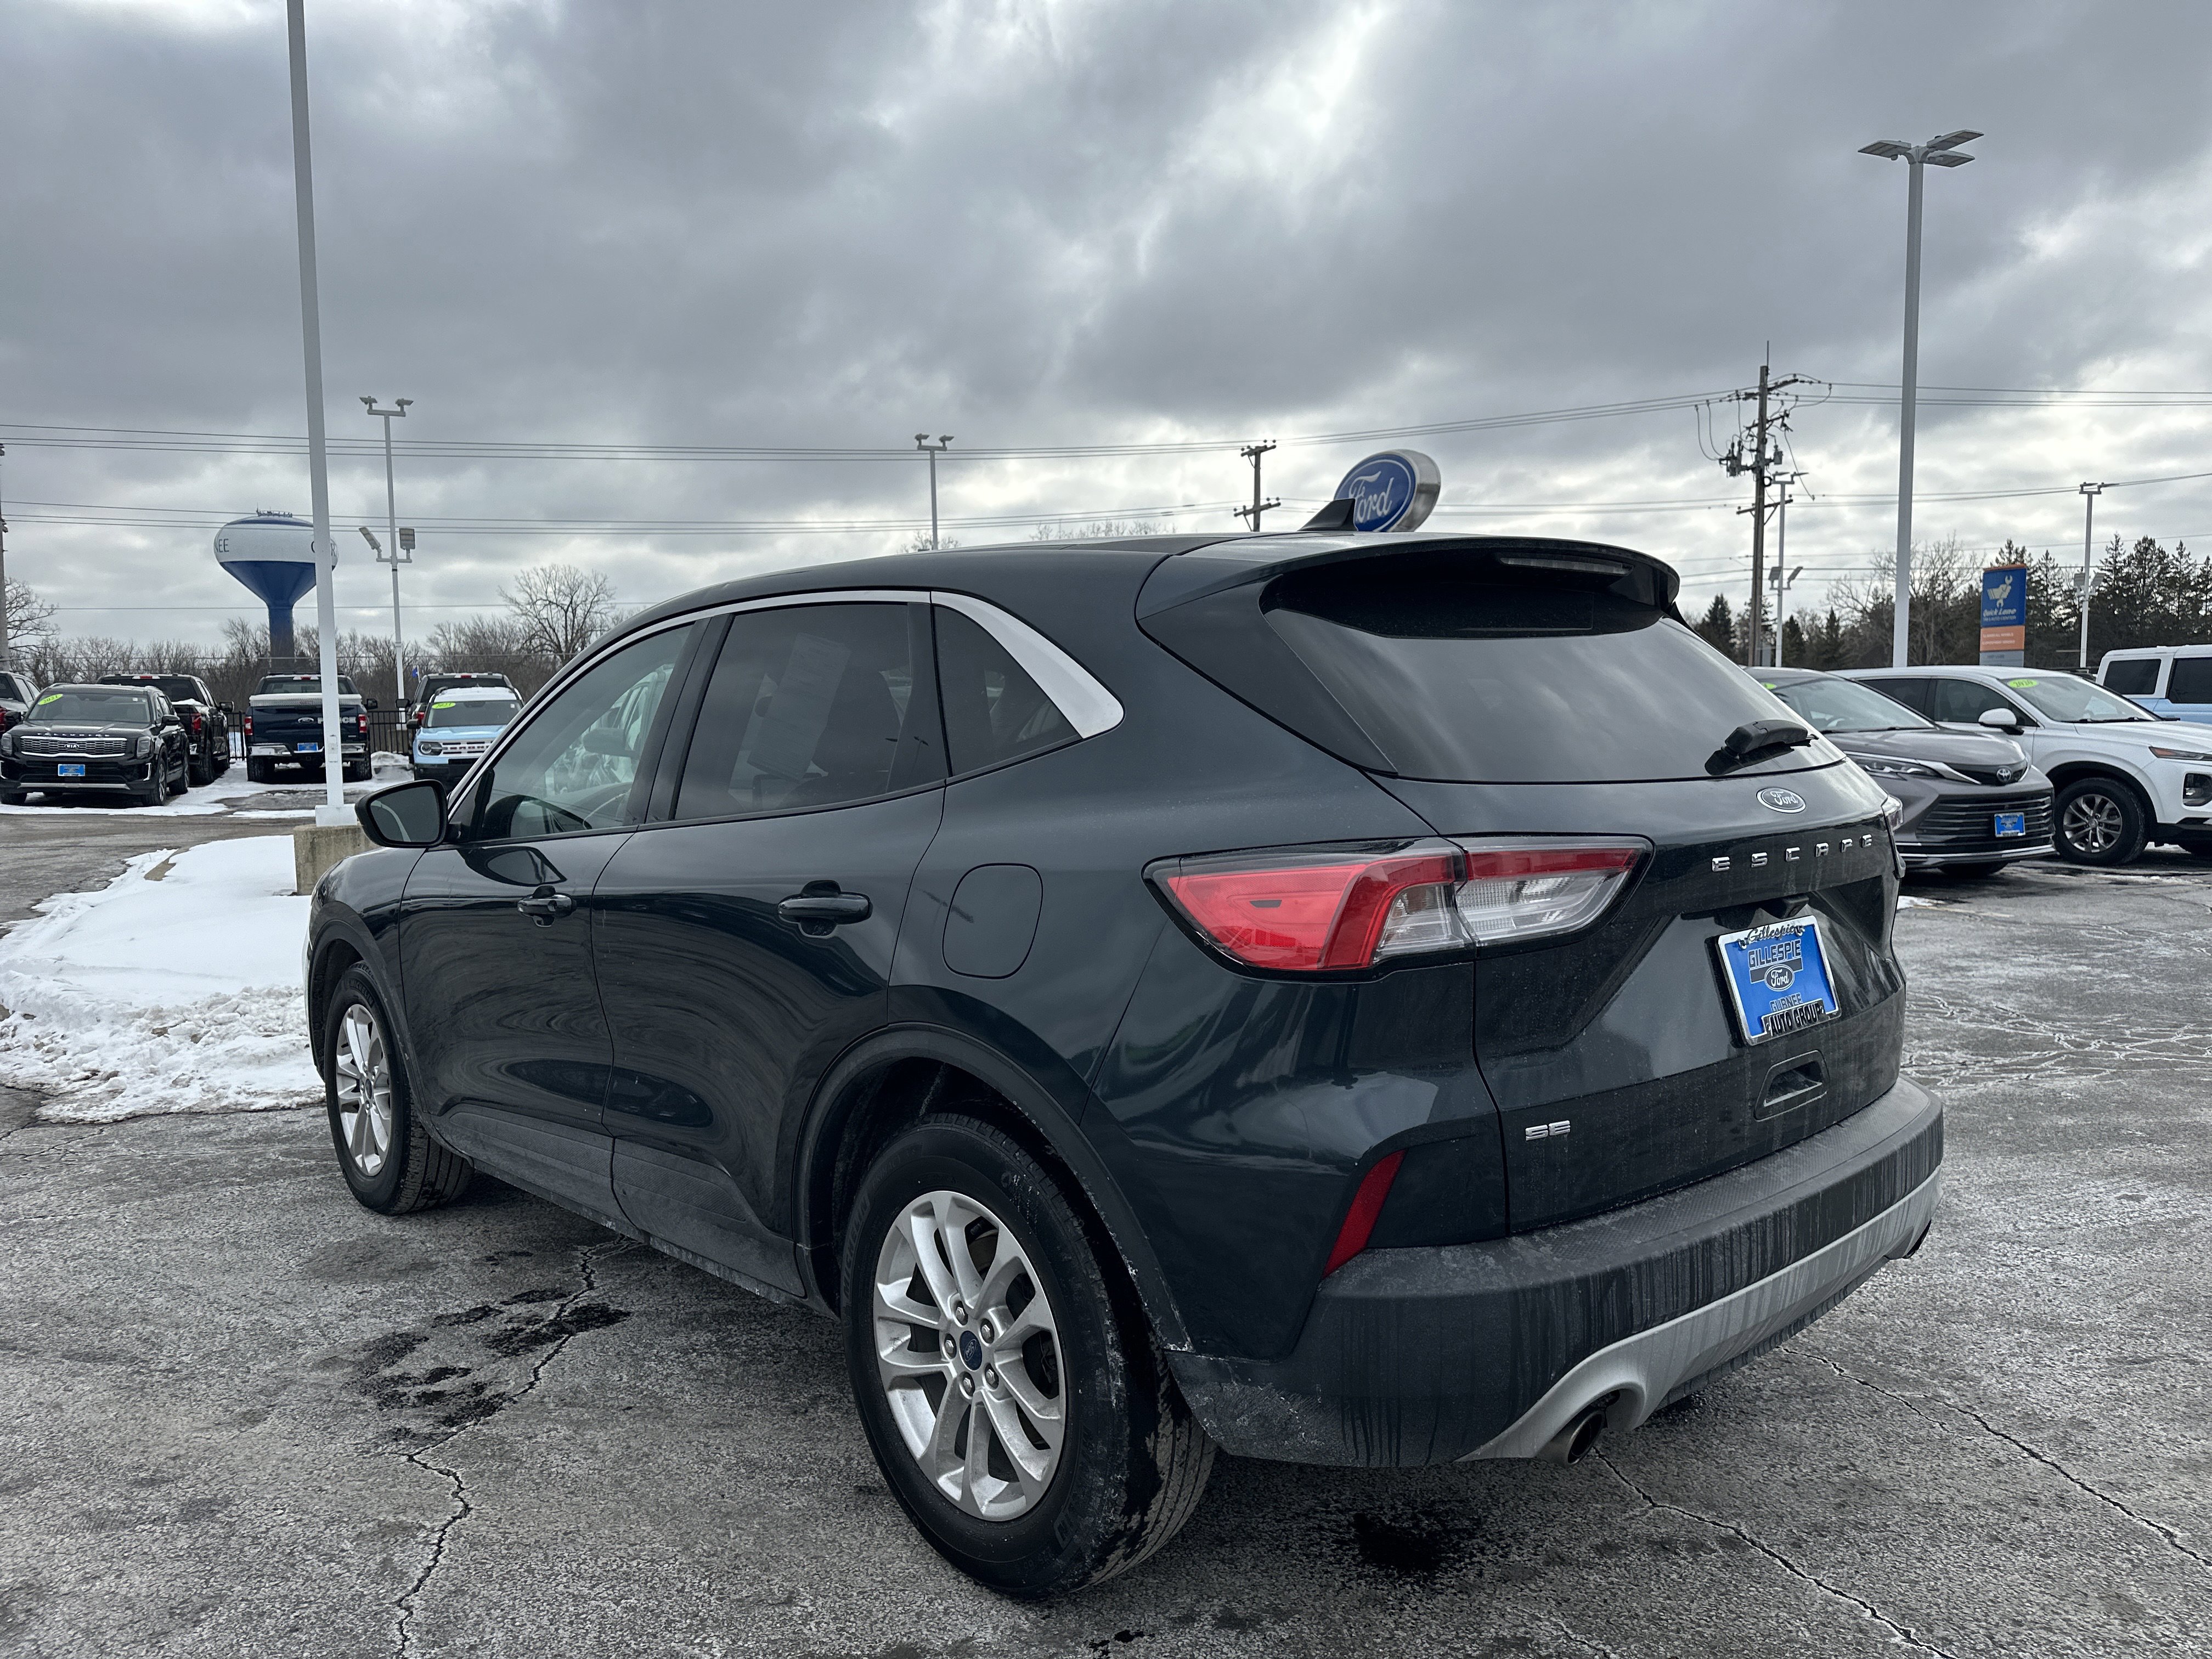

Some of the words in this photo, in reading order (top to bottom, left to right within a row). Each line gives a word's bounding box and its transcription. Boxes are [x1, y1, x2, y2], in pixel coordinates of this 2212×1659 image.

[1348, 471, 1394, 523] Ford
[1997, 607, 2016, 616] Lane
[1770, 791, 1798, 805] Ford
[1712, 834, 1872, 872] ESCAPE
[1748, 924, 1798, 942] Gillespie
[1748, 939, 1802, 969] GILLESPIE
[1770, 969, 1790, 987] Ford
[1769, 992, 1803, 1012] GURNEE
[1769, 1013, 1793, 1036] AUTO
[1793, 1002, 1820, 1026] GROUP
[1525, 1120, 1571, 1141] SE
